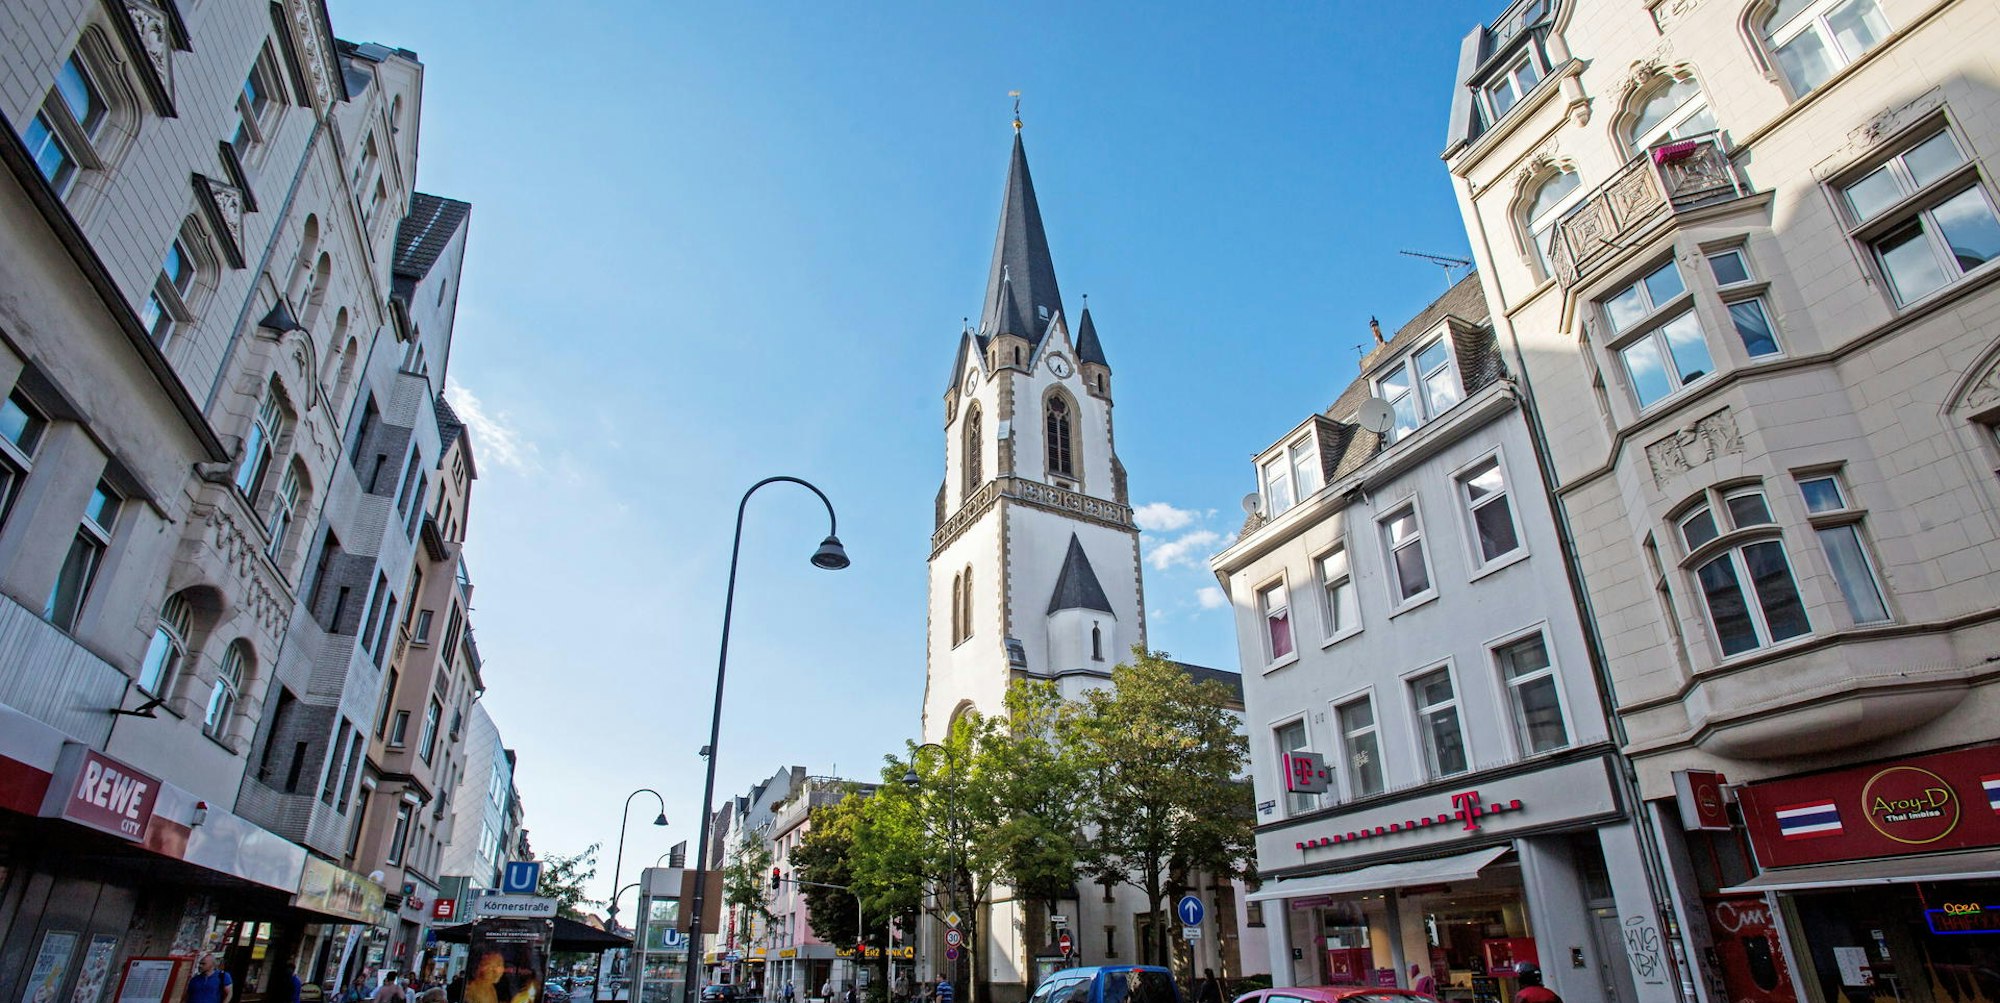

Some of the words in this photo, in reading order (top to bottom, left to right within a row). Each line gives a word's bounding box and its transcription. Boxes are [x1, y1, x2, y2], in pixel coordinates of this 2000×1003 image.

[1295, 757, 1314, 785] T
[77, 759, 147, 820] REWE
[1451, 790, 1481, 831] T
[1872, 787, 1949, 816] Aroy-D
[1885, 813, 1908, 822] Thai
[121, 819, 141, 835] CITY
[510, 865, 533, 890] U
[484, 901, 550, 912] Körnerstraße
[1943, 902, 1981, 916] Open
[663, 928, 681, 946] U
[948, 933, 959, 942] 30
